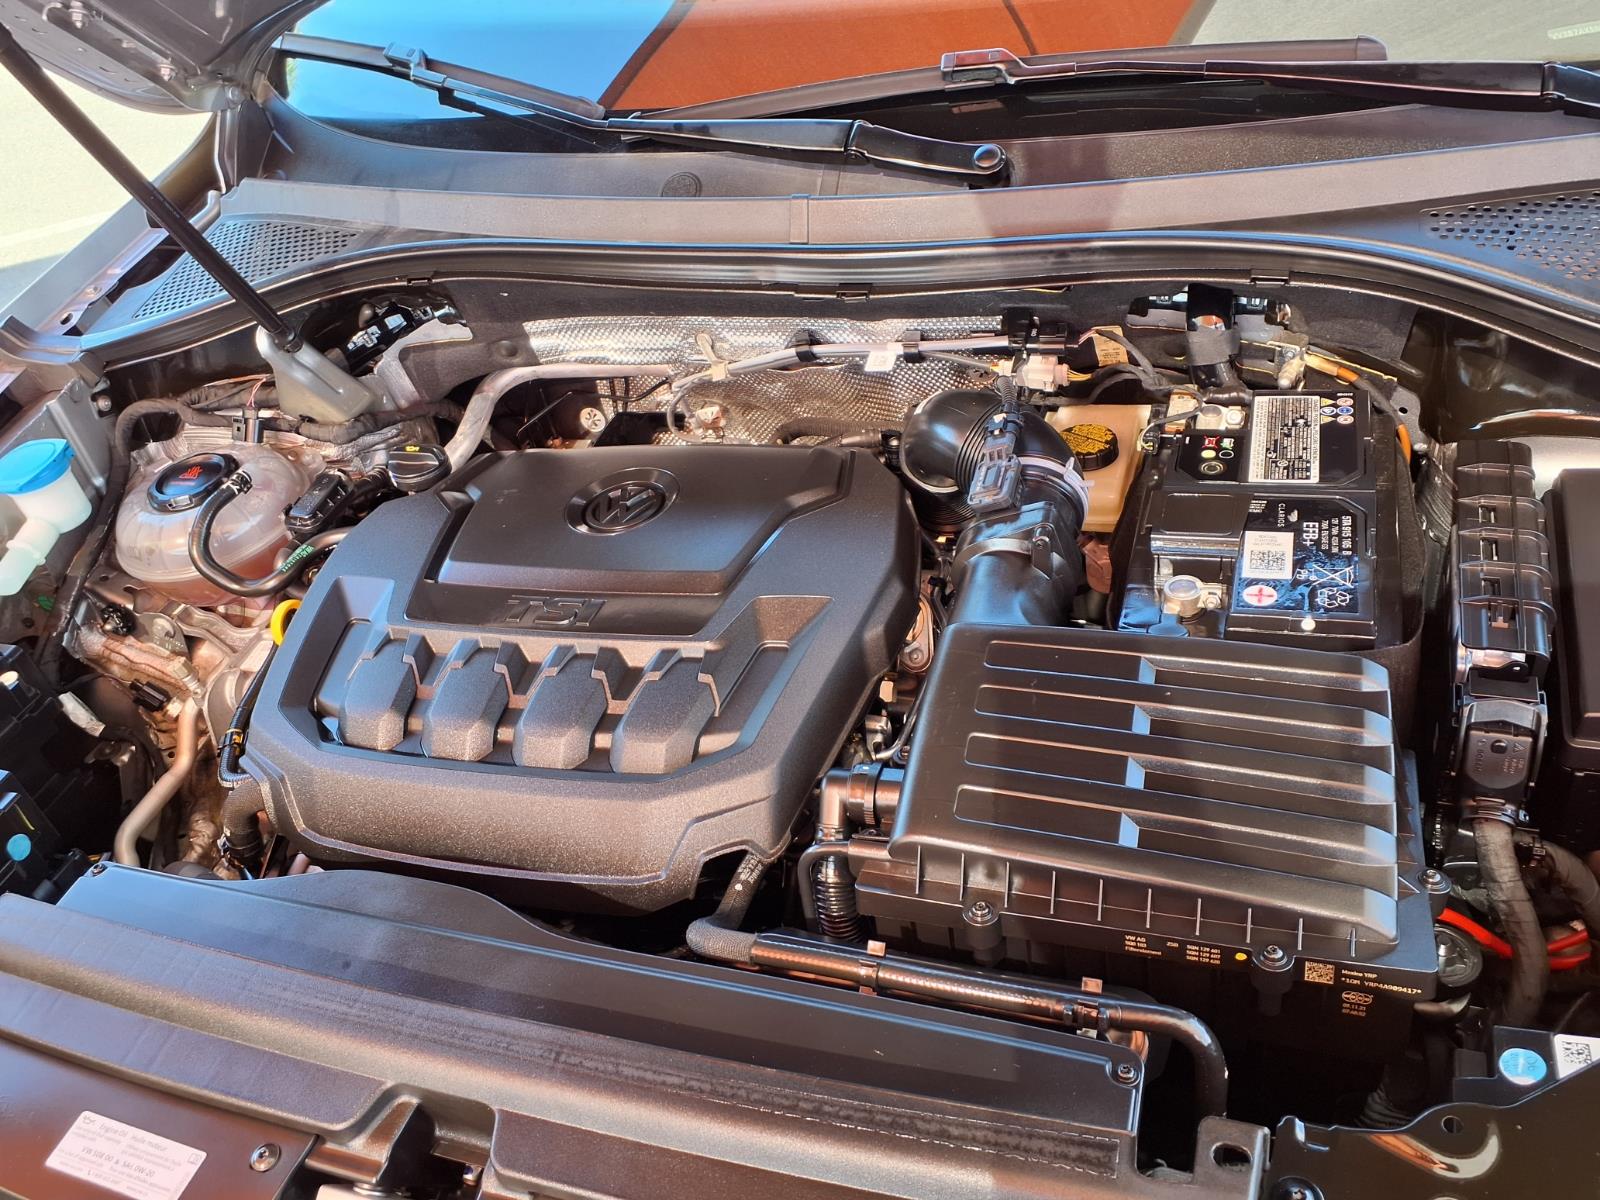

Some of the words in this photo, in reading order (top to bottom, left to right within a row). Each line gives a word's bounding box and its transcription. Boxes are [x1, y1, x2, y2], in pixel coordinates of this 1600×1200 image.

[1277, 503, 1286, 527] CLARIOS
[1302, 521, 1319, 546] EFB+
[1341, 526, 1352, 538] 915
[504, 594, 607, 627] TSI
